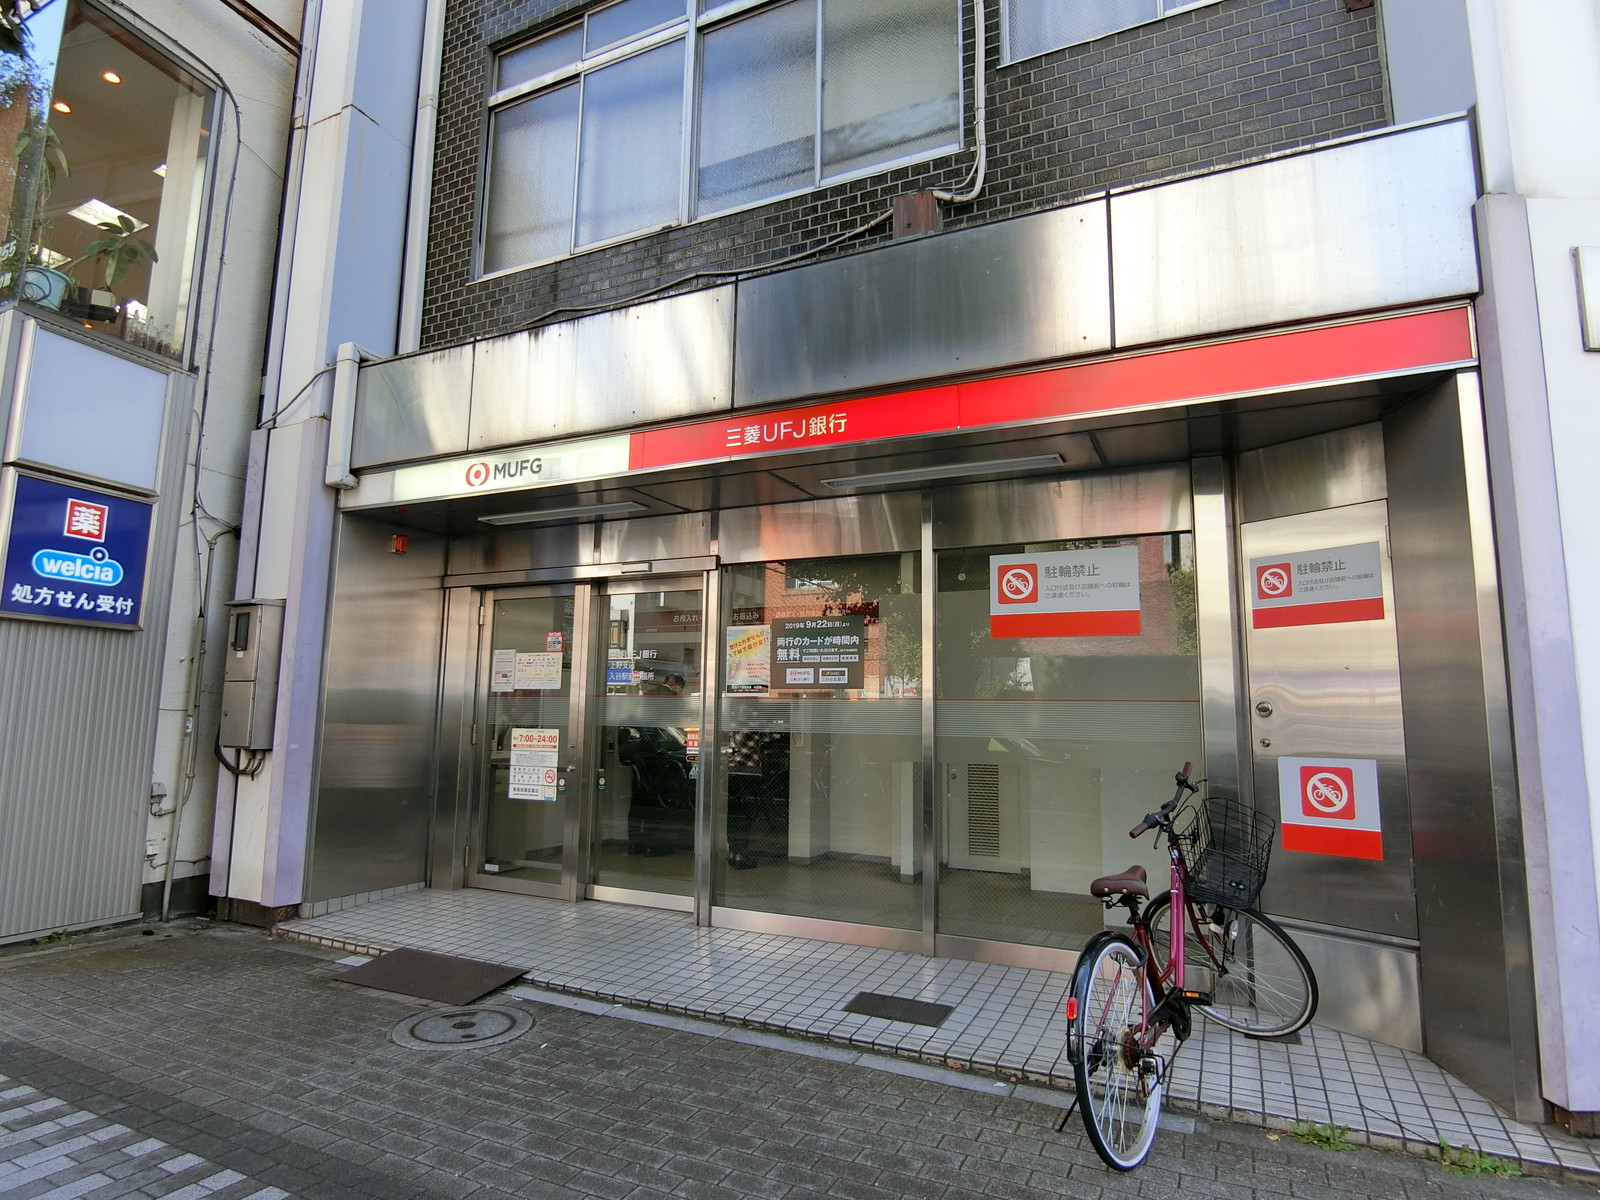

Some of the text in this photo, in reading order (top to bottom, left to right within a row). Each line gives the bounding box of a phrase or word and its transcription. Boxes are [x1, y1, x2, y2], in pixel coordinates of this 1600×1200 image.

[726, 413, 848, 447] 三菱UFJ銀行
[494, 458, 542, 480] MUFG
[71, 506, 101, 536] 薬
[43, 556, 115, 582] welcia
[1044, 564, 1100, 578] 駐輪禁止
[1296, 560, 1346, 575] 駐輪禁止
[11, 583, 134, 615] 処方せん受付
[776, 635, 859, 647] 両行のカードが時間内
[776, 648, 800, 660] 無料
